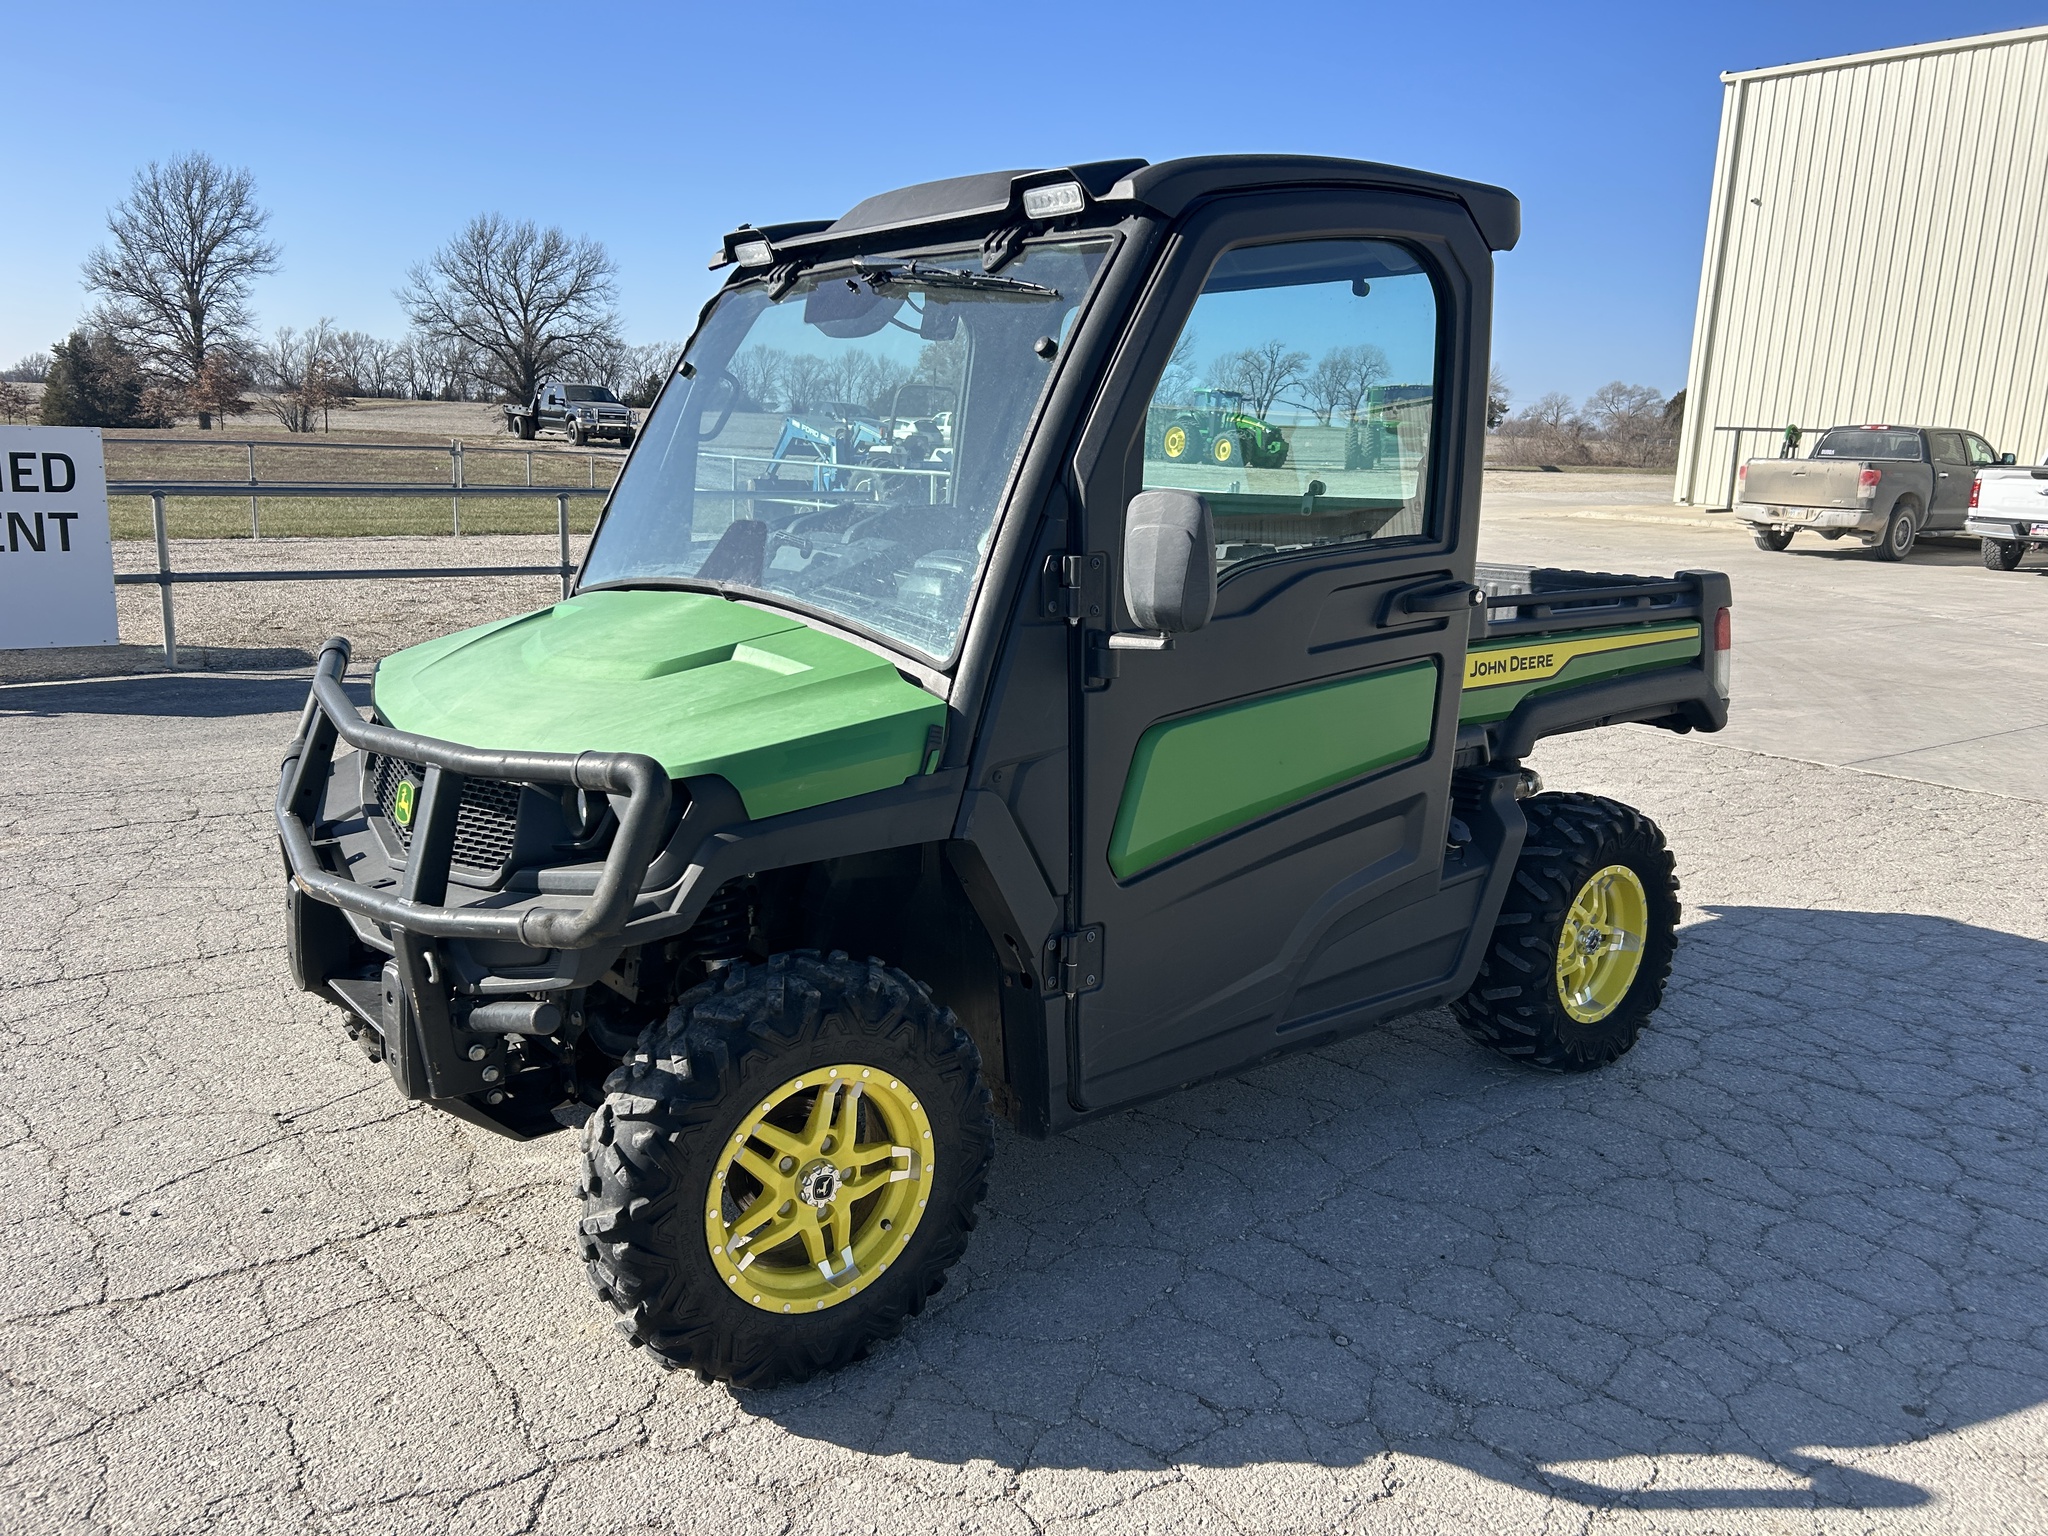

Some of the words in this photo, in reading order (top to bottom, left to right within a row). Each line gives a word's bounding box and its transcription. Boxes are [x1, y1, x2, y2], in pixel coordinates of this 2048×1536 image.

[801, 424, 820, 438] FORD
[0, 512, 78, 552] NT
[1470, 660, 1507, 677] JOHN
[1510, 654, 1554, 672] DEERE
